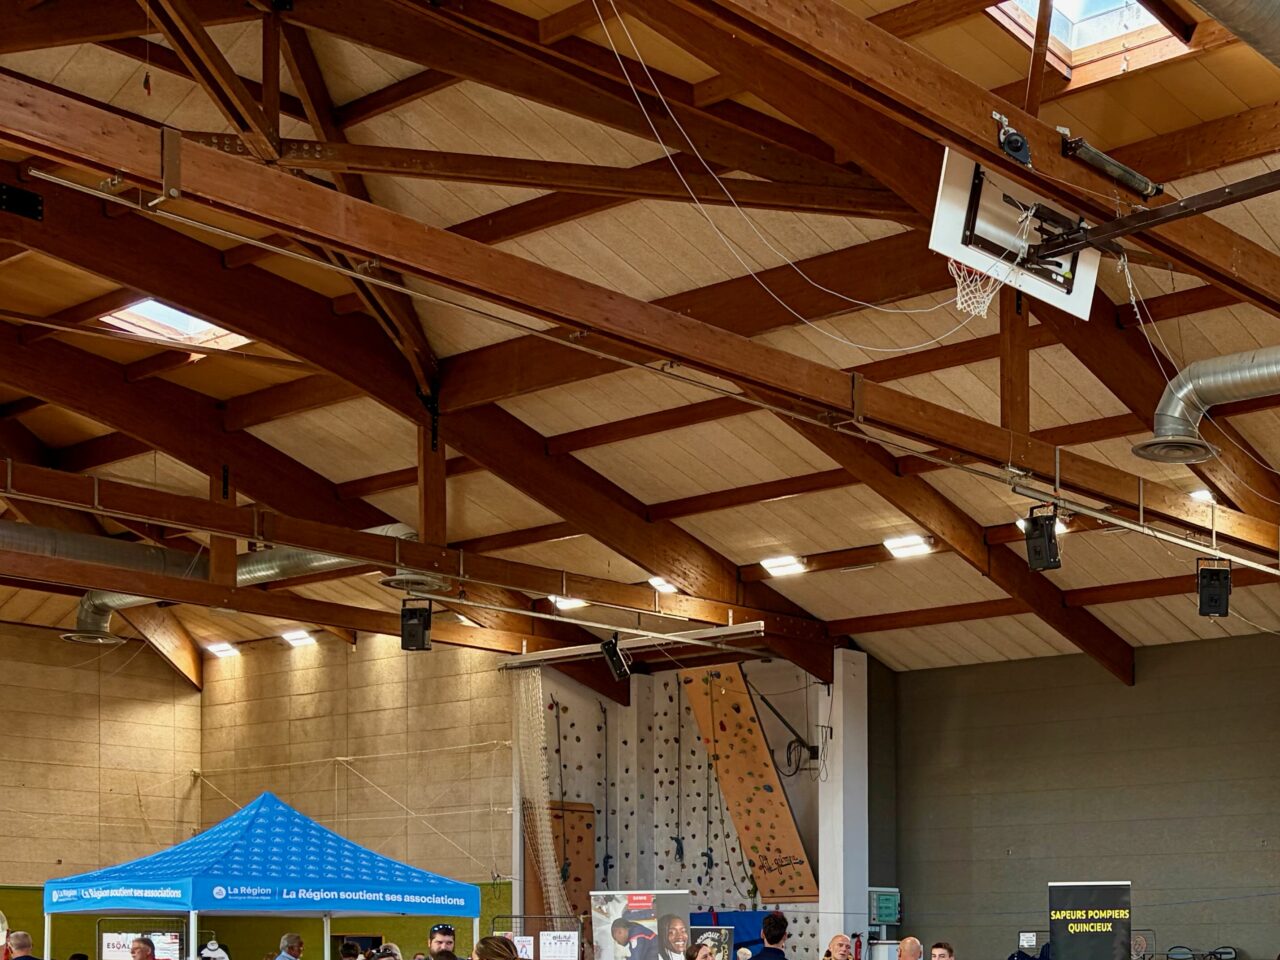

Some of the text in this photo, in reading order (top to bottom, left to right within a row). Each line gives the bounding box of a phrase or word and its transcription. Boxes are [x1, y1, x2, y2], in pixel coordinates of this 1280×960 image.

[90, 887, 109, 900] Région
[110, 886, 134, 897] soutient
[144, 887, 182, 899] associations
[228, 886, 272, 896] La Région
[283, 889, 465, 906] La Région soutient ses associations
[1050, 909, 1130, 920] SAPEURS POMPIERS
[1067, 922, 1113, 934] QUINCIEUX
